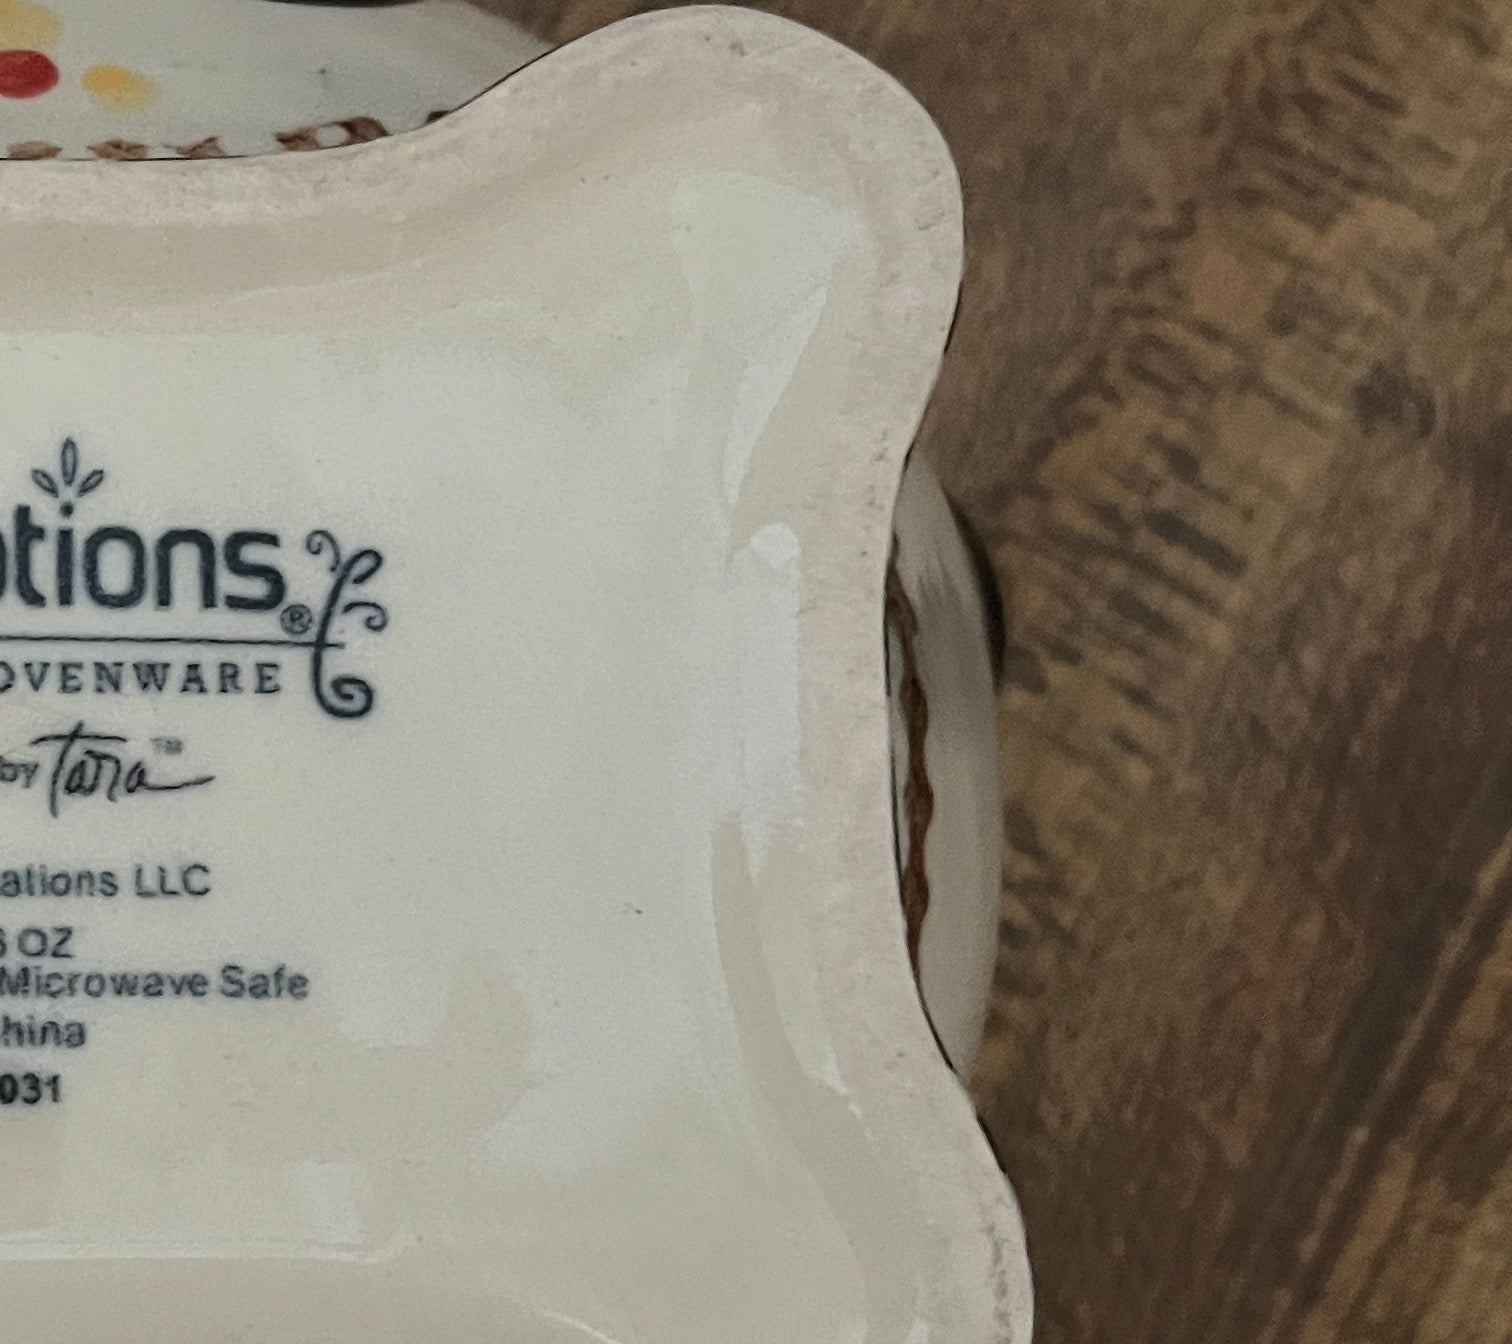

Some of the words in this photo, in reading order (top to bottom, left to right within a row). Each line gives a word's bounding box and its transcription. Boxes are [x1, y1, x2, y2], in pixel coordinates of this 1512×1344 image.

[133, 862, 212, 899] LLC
[16, 926, 76, 960] OZ
[220, 964, 310, 1002] Safe
